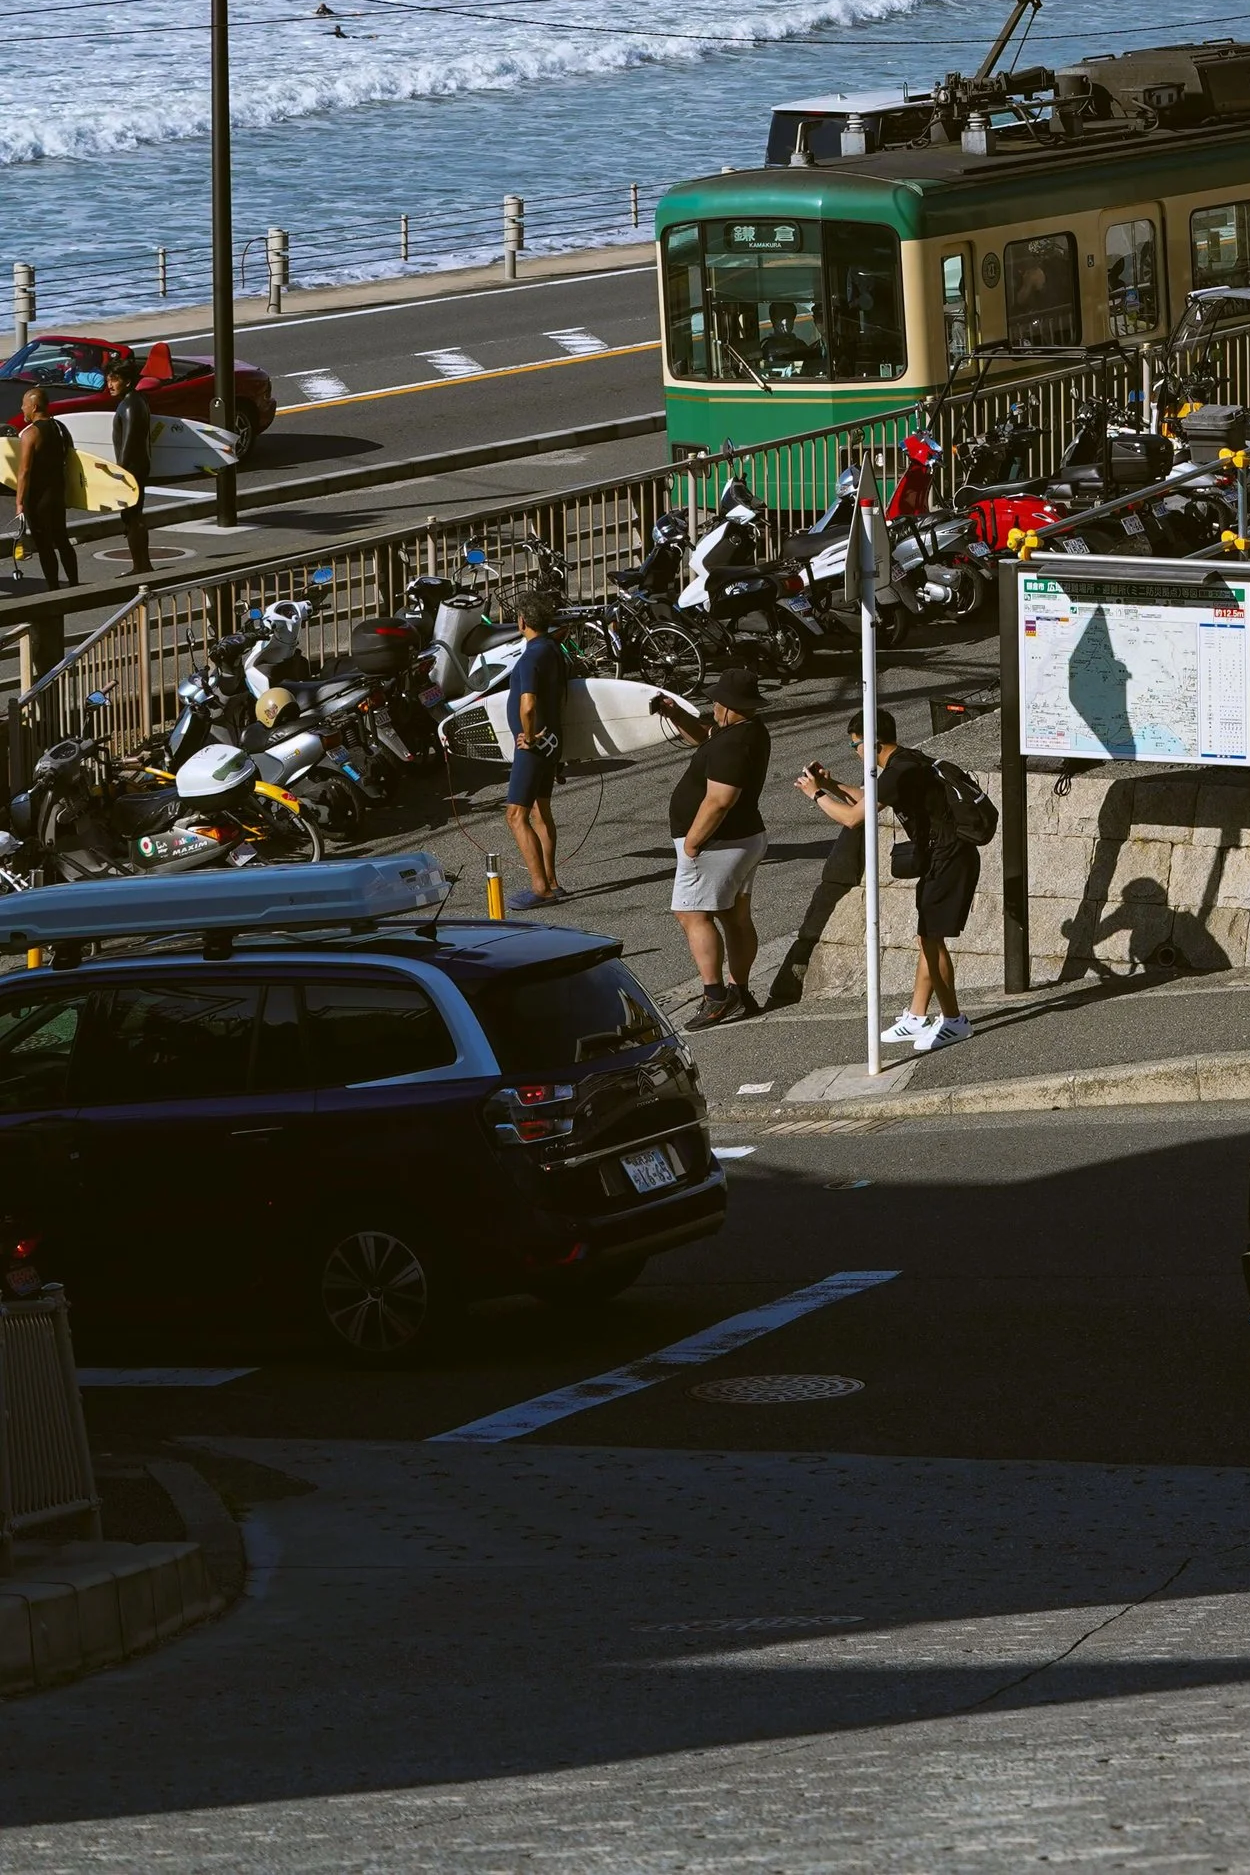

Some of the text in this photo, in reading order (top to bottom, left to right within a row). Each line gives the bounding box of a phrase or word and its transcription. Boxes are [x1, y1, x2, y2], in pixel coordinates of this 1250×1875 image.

[733, 225, 796, 242] 鎌倉
[1215, 609, 1244, 618] 約12.5m
[172, 840, 208, 856] MAXIM
